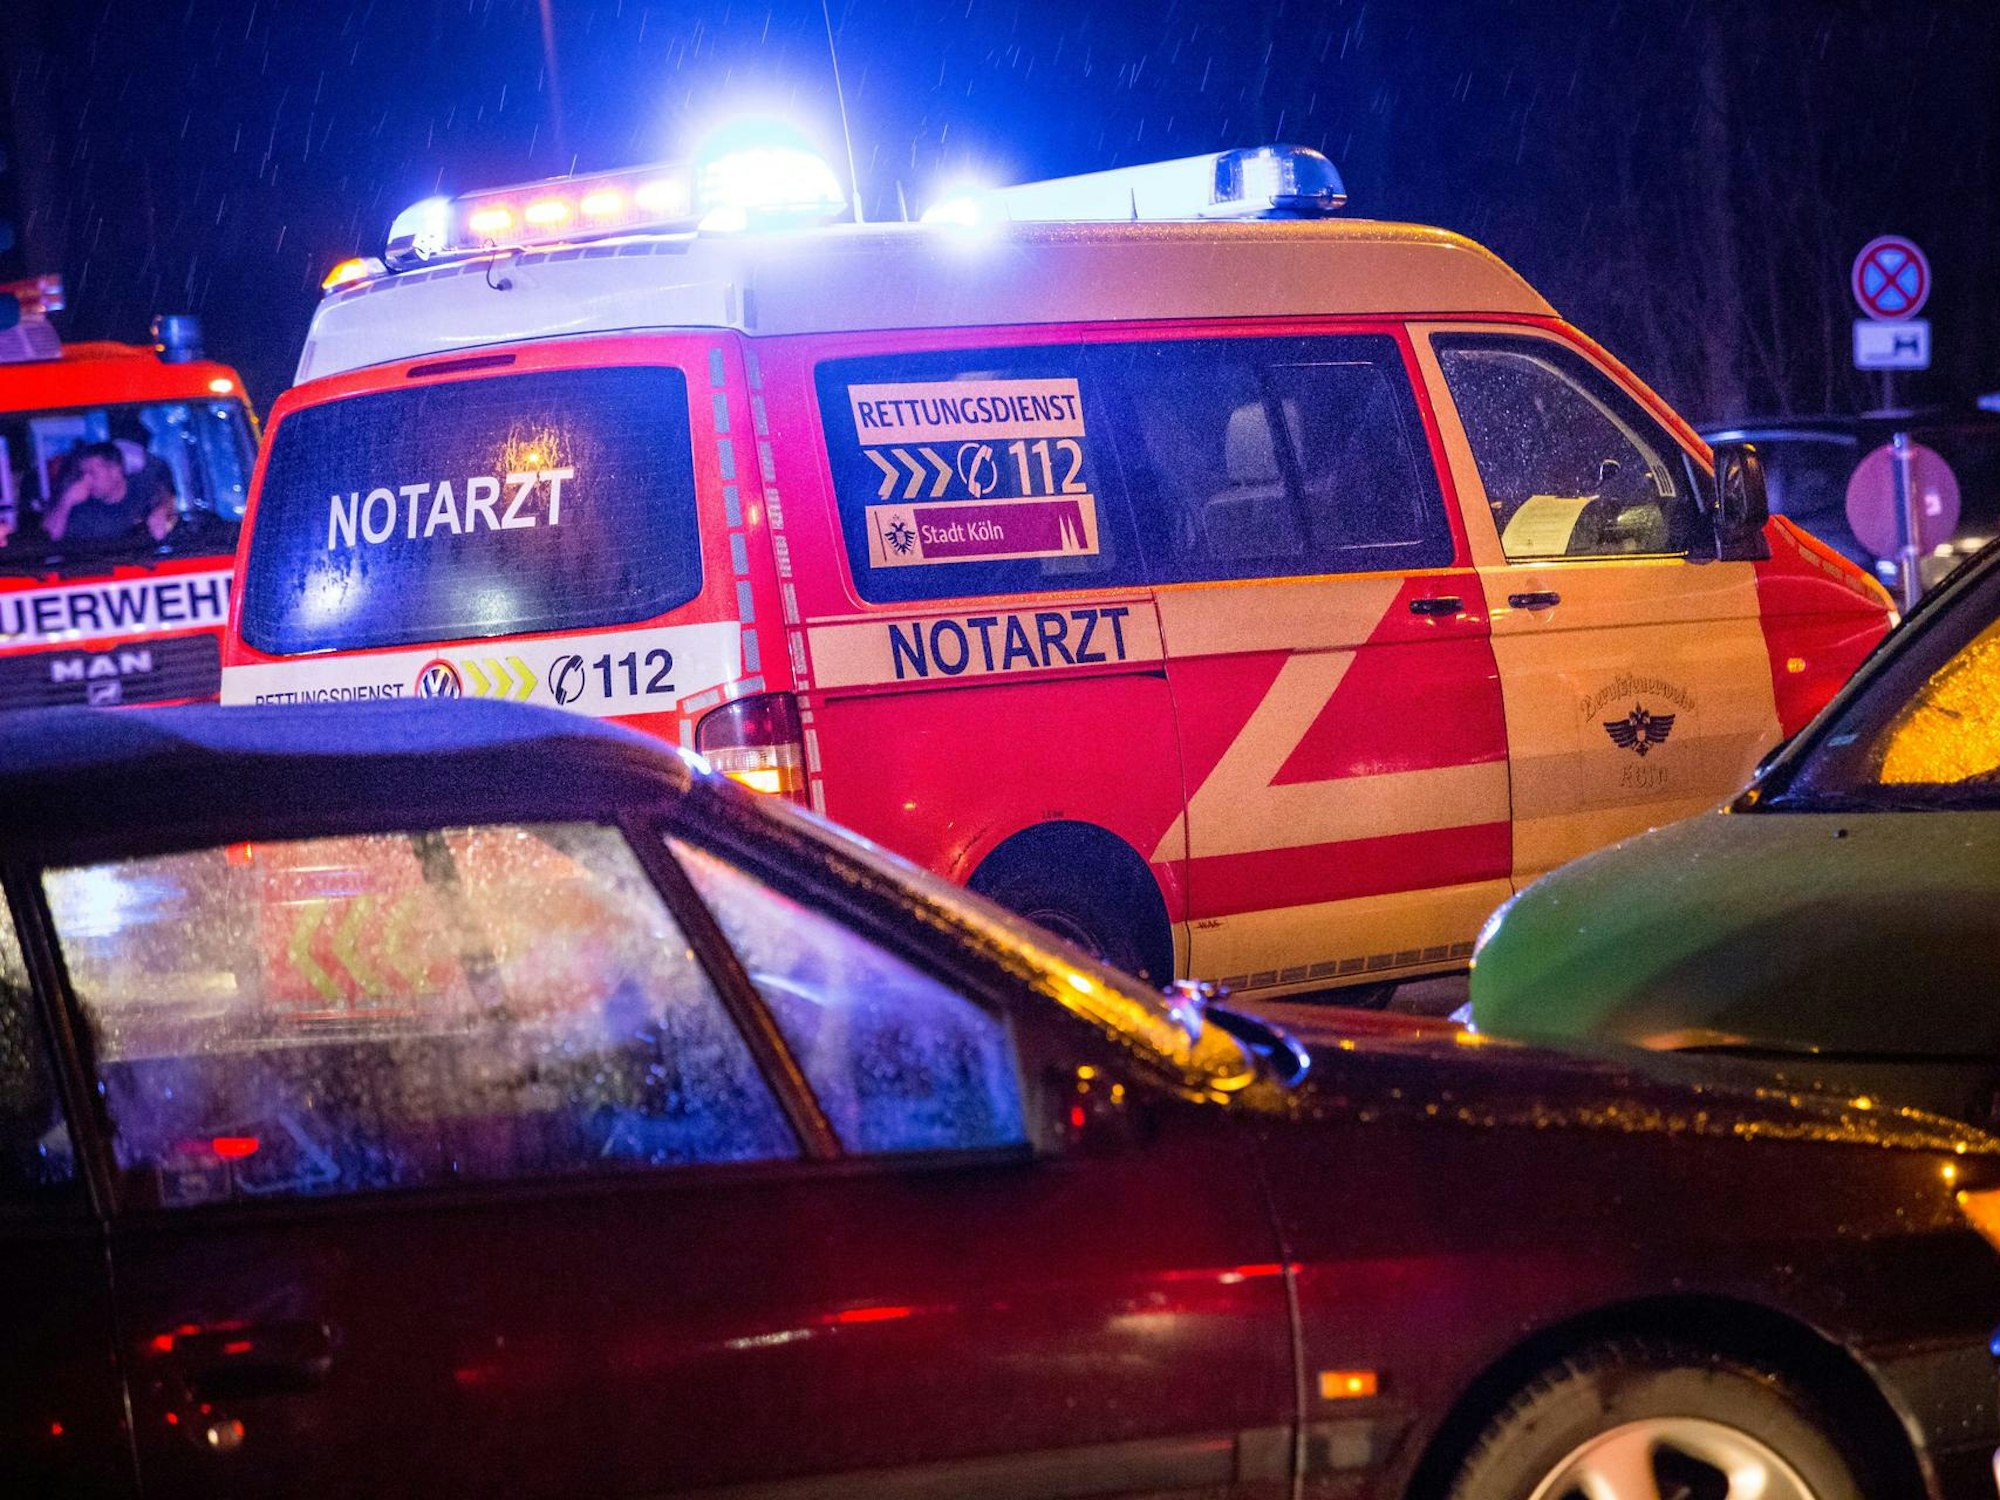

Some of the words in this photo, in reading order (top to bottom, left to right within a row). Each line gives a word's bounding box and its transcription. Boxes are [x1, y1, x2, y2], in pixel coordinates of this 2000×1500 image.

[857, 394, 1077, 429] RETTUNGSDIENST
[1008, 439, 1087, 496] 112
[327, 468, 575, 551] NOTARZT
[921, 522, 966, 545] Stadt
[967, 520, 1005, 542] Köln
[0, 577, 234, 637] UERWEH
[51, 650, 152, 683] MAN
[887, 606, 1130, 680] NOTARZT
[593, 648, 676, 698] 112
